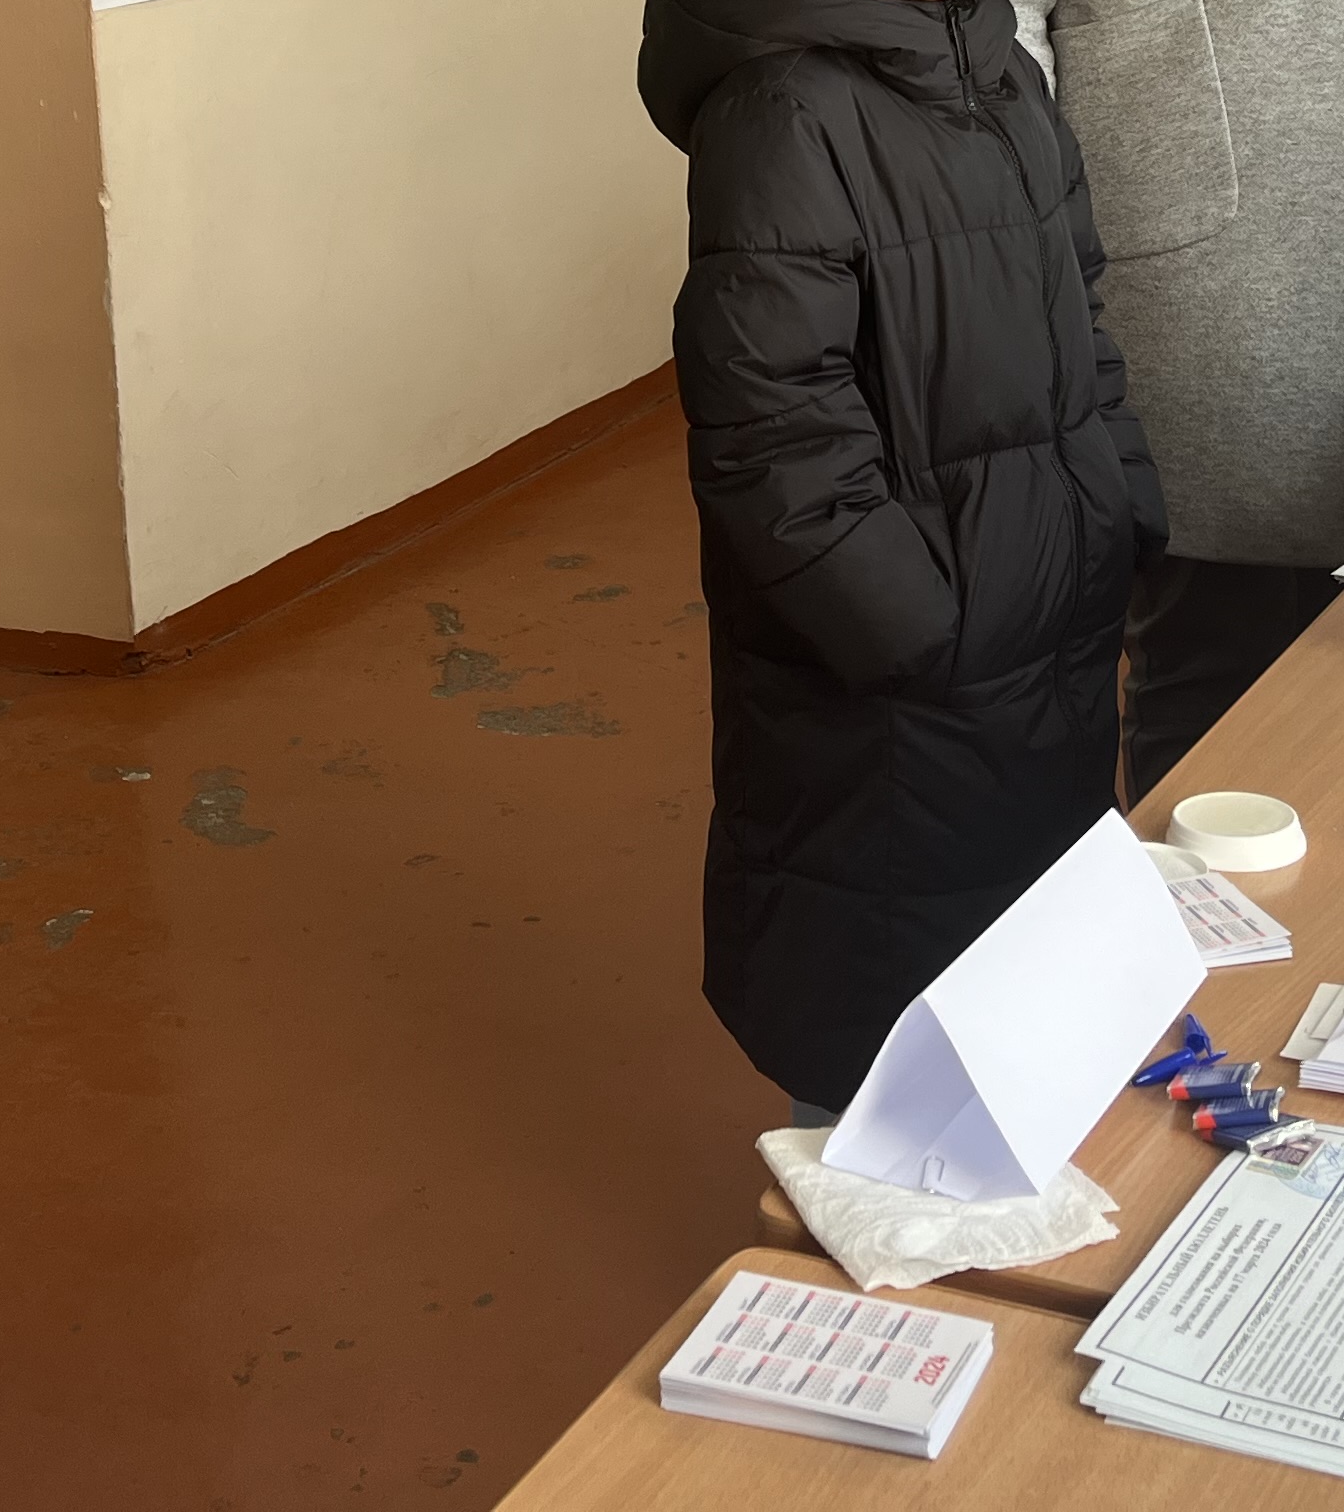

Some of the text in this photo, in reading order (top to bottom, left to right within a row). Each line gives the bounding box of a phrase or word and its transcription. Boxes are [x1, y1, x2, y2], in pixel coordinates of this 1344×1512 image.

[1135, 1206, 1229, 1321] ИЗБИРАТЕЛЬНЫЙ БЮЛЛЕТЕНЬ
[1233, 1273, 1245, 1284] 17
[1174, 1294, 1210, 1335] Президента
[1204, 1255, 1238, 1295] Российской
[914, 1354, 950, 1387] 2024
